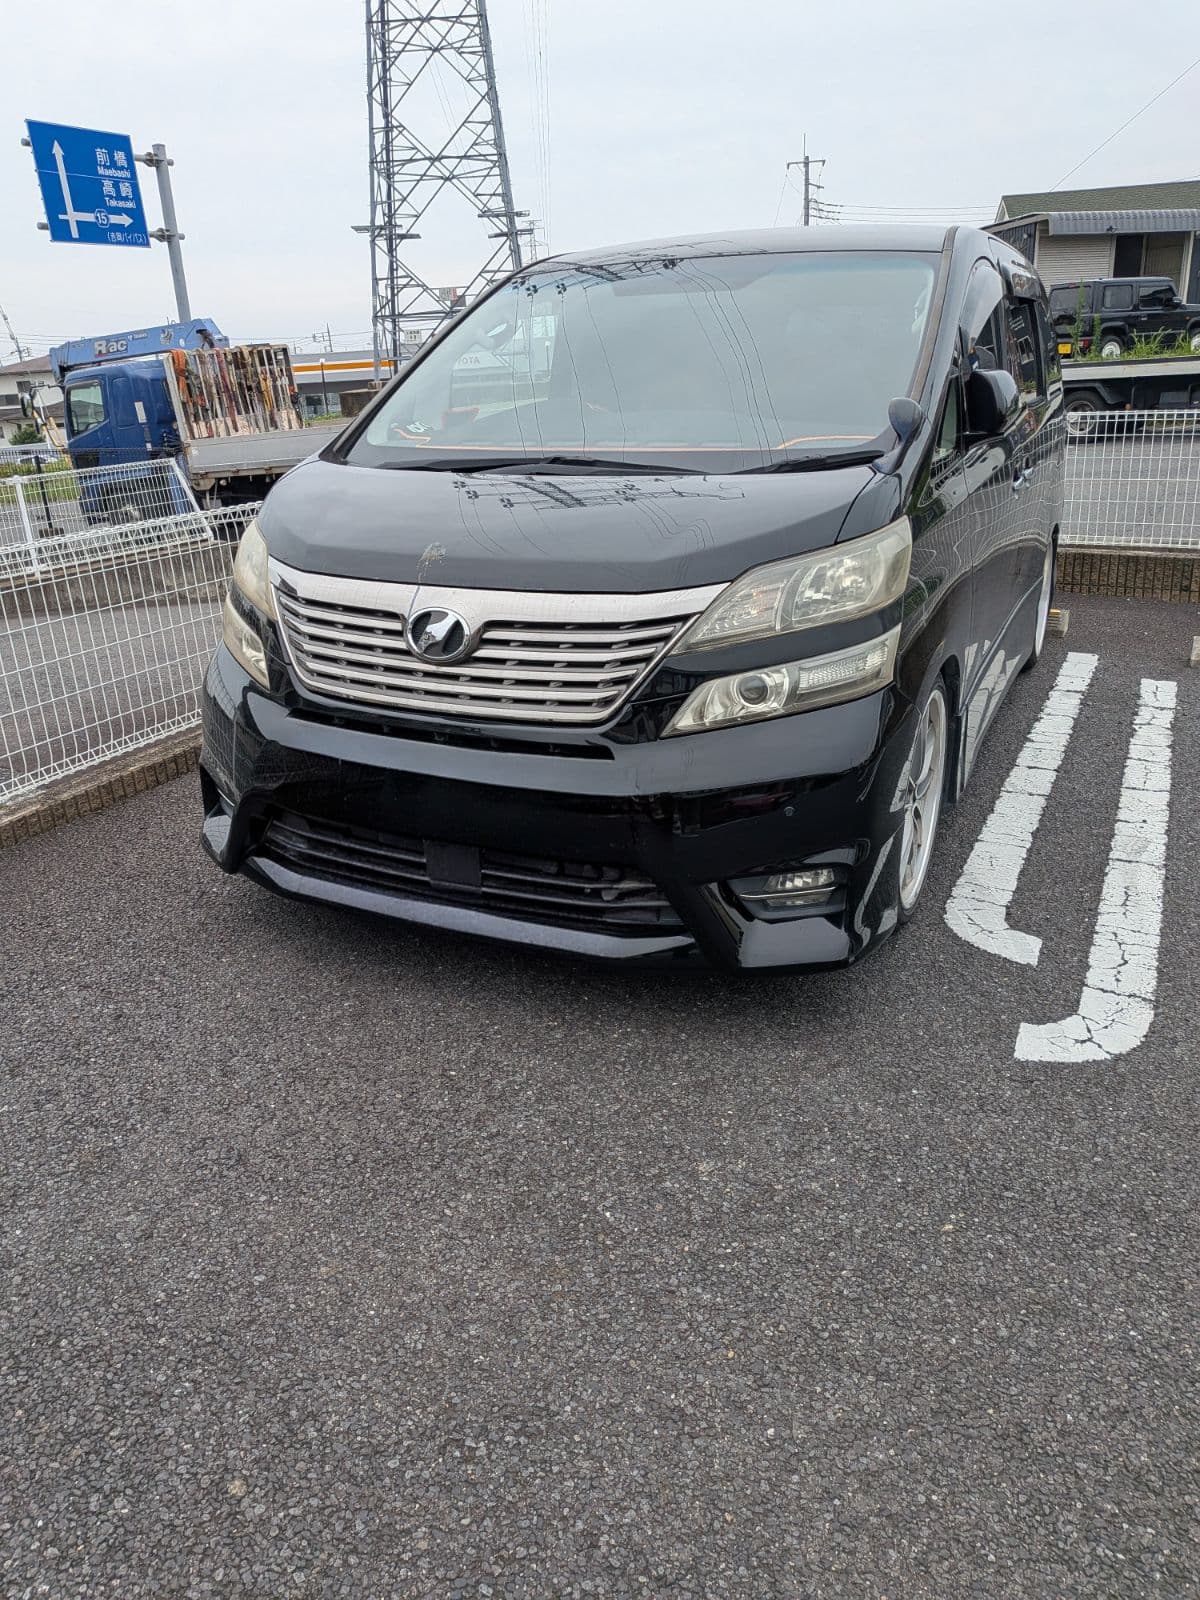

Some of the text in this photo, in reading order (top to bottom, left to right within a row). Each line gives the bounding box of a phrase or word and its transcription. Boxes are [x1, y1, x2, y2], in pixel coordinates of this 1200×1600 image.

[95, 148, 128, 168] 前橋
[97, 165, 132, 178] Maebashi
[101, 179, 133, 198] 高崎
[104, 197, 136, 208] Takasaki
[97, 212, 107, 225] 15
